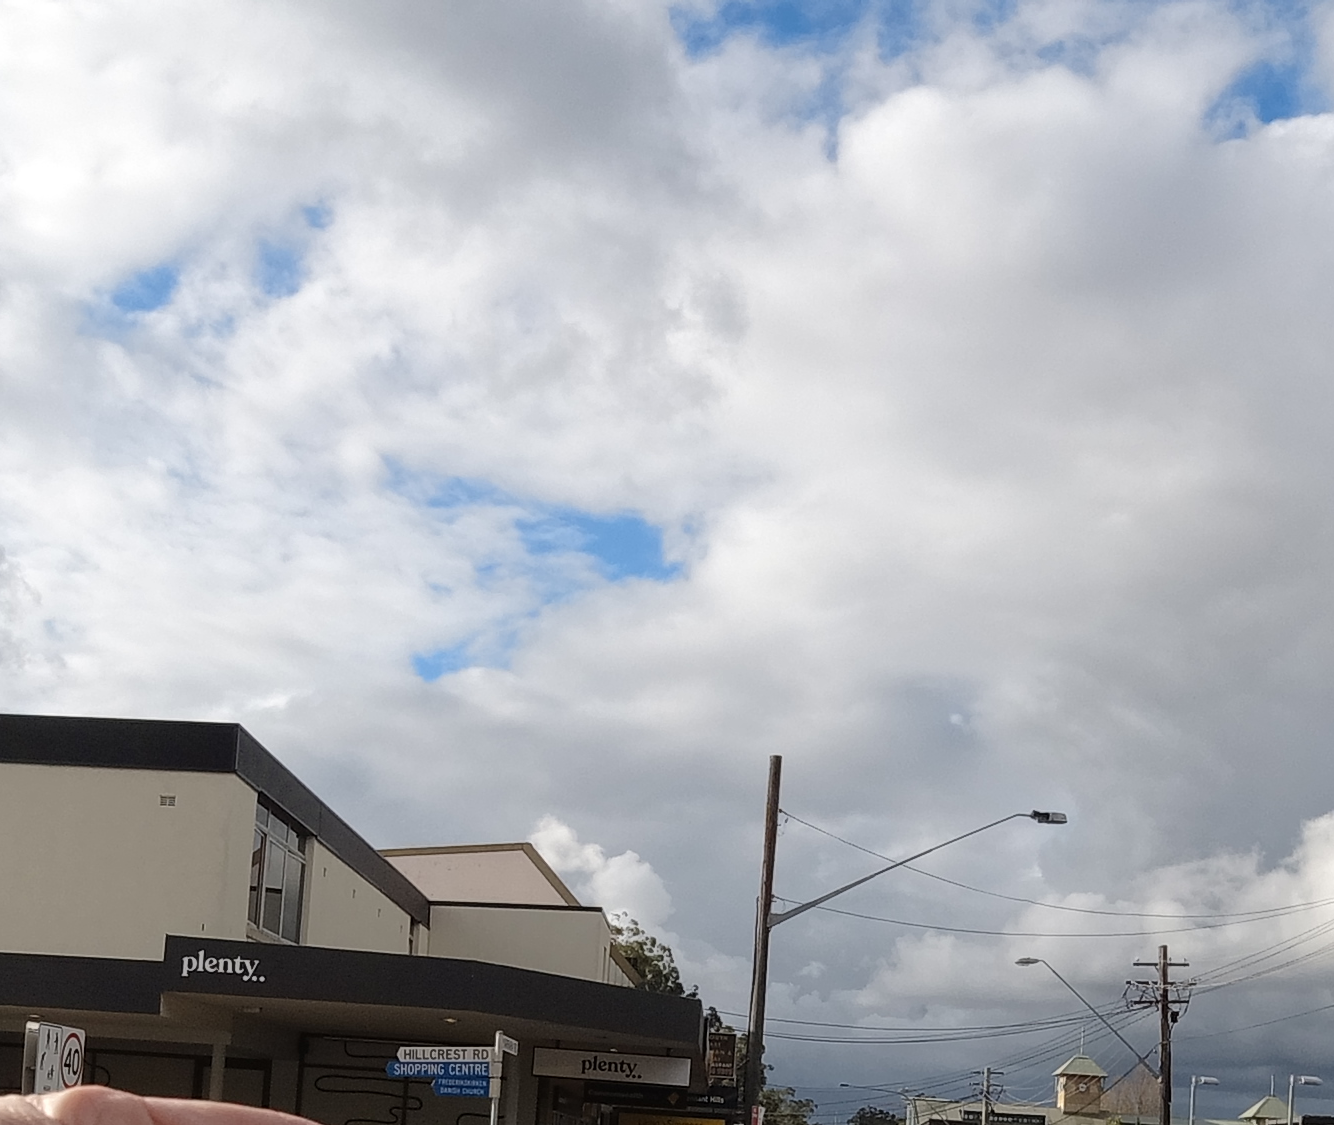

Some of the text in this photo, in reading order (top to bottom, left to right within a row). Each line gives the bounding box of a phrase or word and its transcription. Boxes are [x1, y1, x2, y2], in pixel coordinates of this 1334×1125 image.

[403, 1048, 489, 1060] HILLCREST RD
[63, 1047, 80, 1076] 40
[393, 1063, 488, 1076] SHOPPING CENTRE
